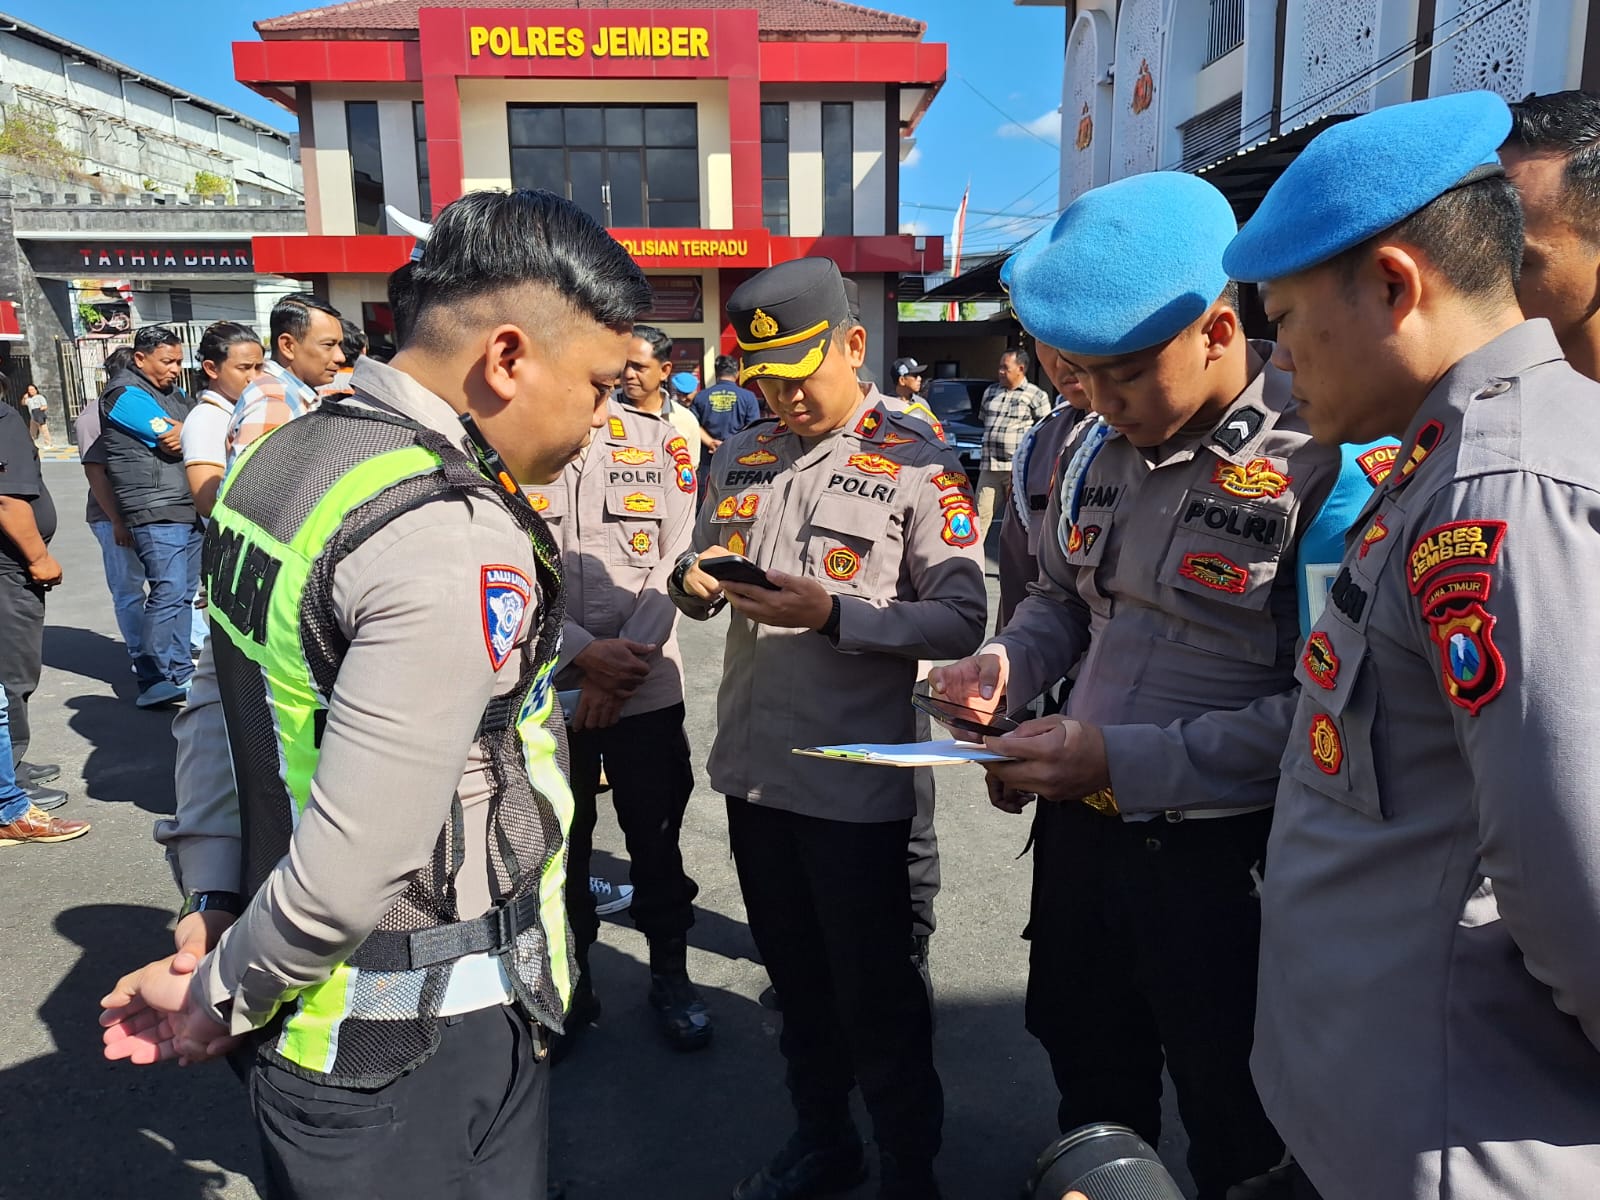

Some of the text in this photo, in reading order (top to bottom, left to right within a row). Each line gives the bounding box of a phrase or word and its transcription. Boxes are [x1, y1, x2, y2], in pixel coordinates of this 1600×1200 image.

[470, 26, 709, 57] POLRES JEMBER
[80, 249, 255, 266] TATHYA DHAR
[682, 240, 748, 257] TERPADU
[1364, 448, 1400, 469] POL
[609, 471, 661, 484] POLRI
[725, 470, 779, 486] EFFAN
[828, 473, 896, 503] POLRI
[1184, 501, 1277, 545] POLRI
[1412, 526, 1482, 567] POLRES
[1413, 541, 1488, 582] JEMBER
[1448, 581, 1481, 593] TIMUR
